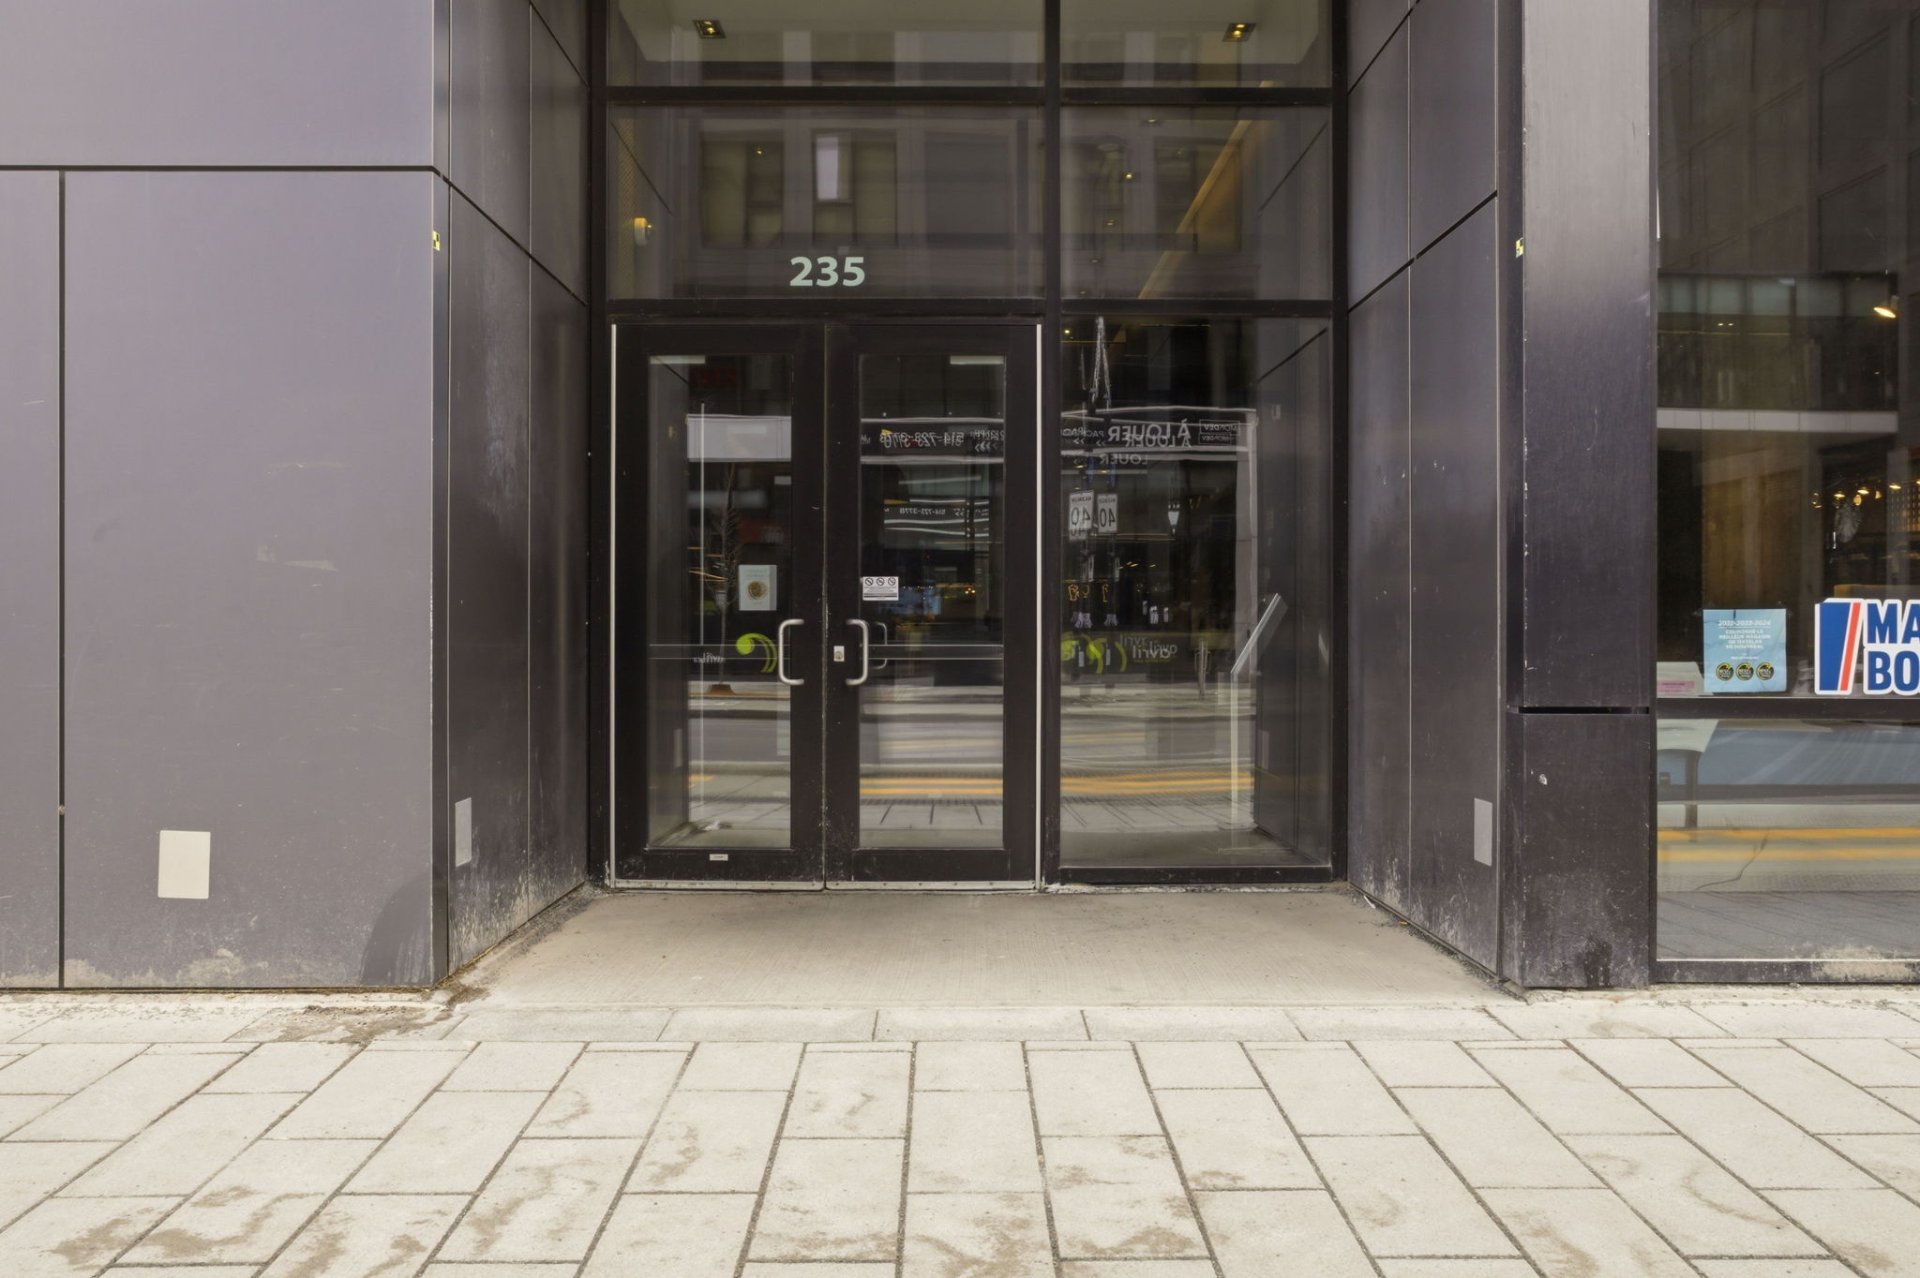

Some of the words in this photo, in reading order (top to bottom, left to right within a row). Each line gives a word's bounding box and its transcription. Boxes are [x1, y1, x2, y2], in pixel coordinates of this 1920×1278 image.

[790, 256, 865, 286] 235
[1867, 603, 1920, 644] MA
[1867, 651, 1920, 692] BO
